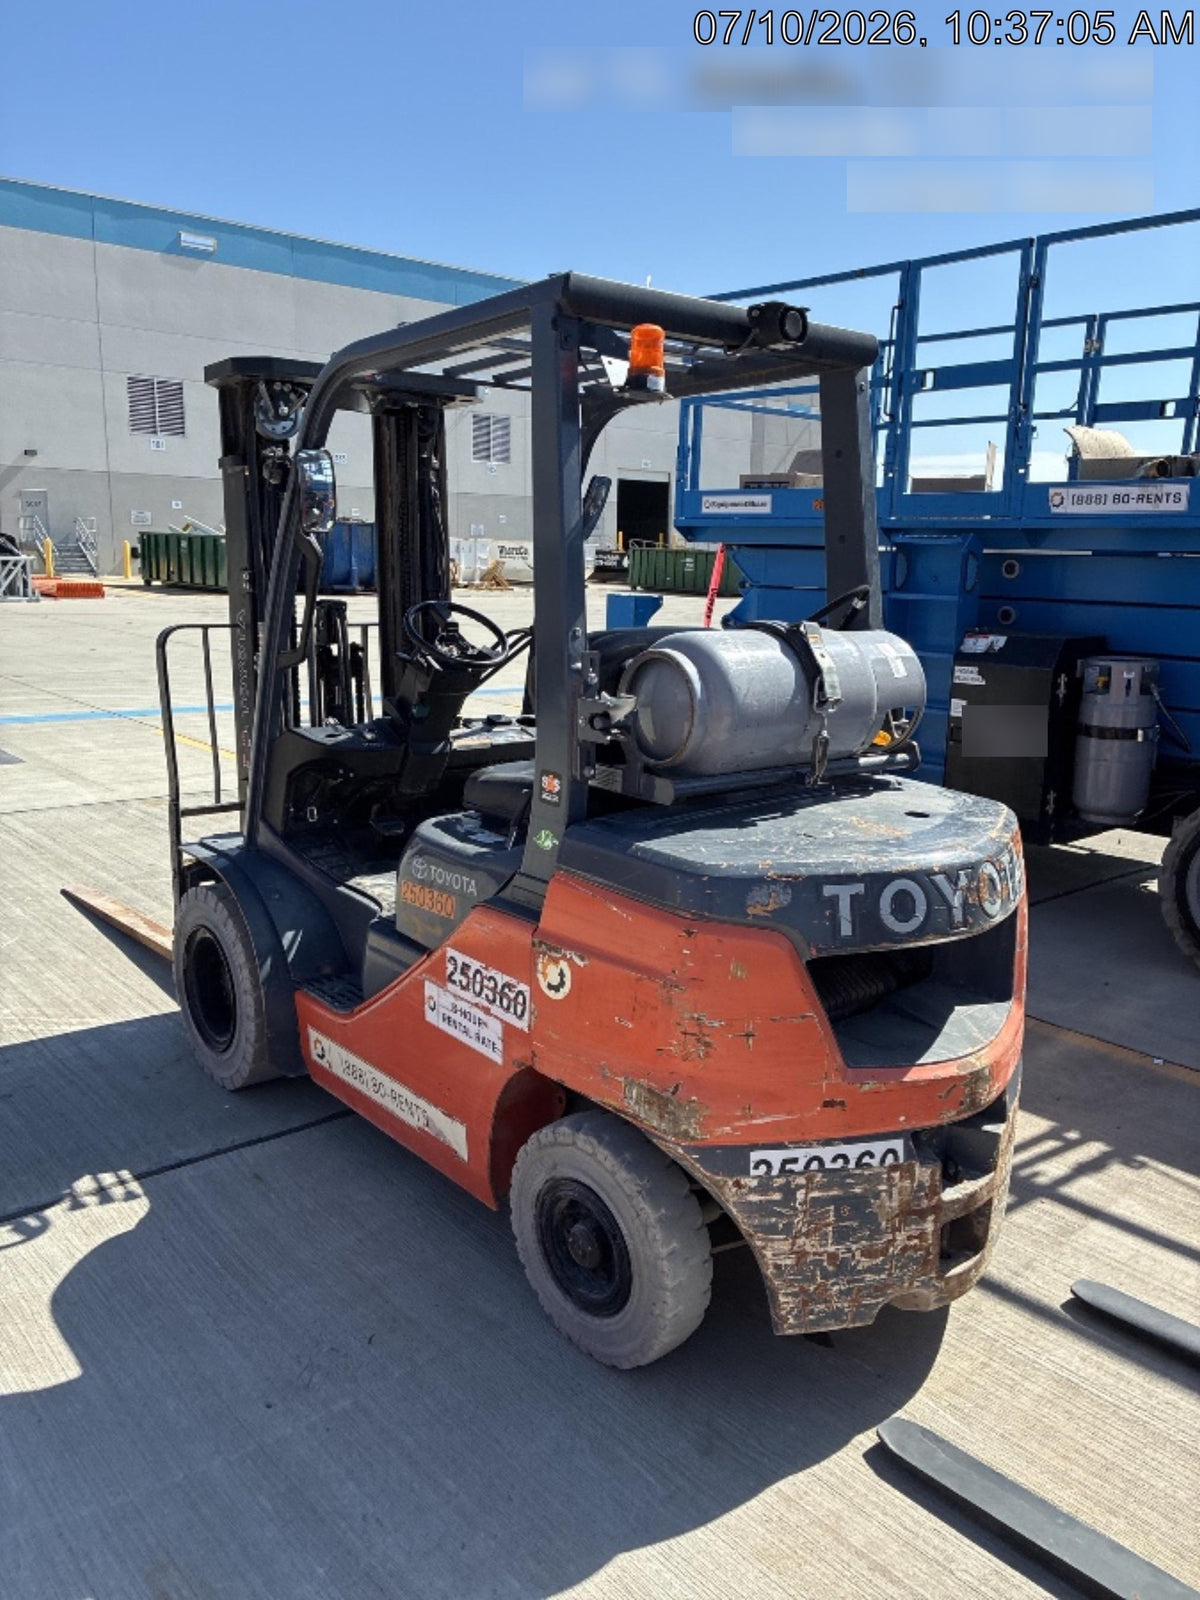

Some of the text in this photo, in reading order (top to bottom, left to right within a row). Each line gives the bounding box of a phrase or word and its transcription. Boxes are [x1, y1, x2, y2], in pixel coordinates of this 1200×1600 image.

[401, 880, 455, 918] 250360
[429, 866, 478, 897] TOYOTA
[446, 955, 527, 1021] 250360
[441, 1012, 499, 1053] RENTAL RATE
